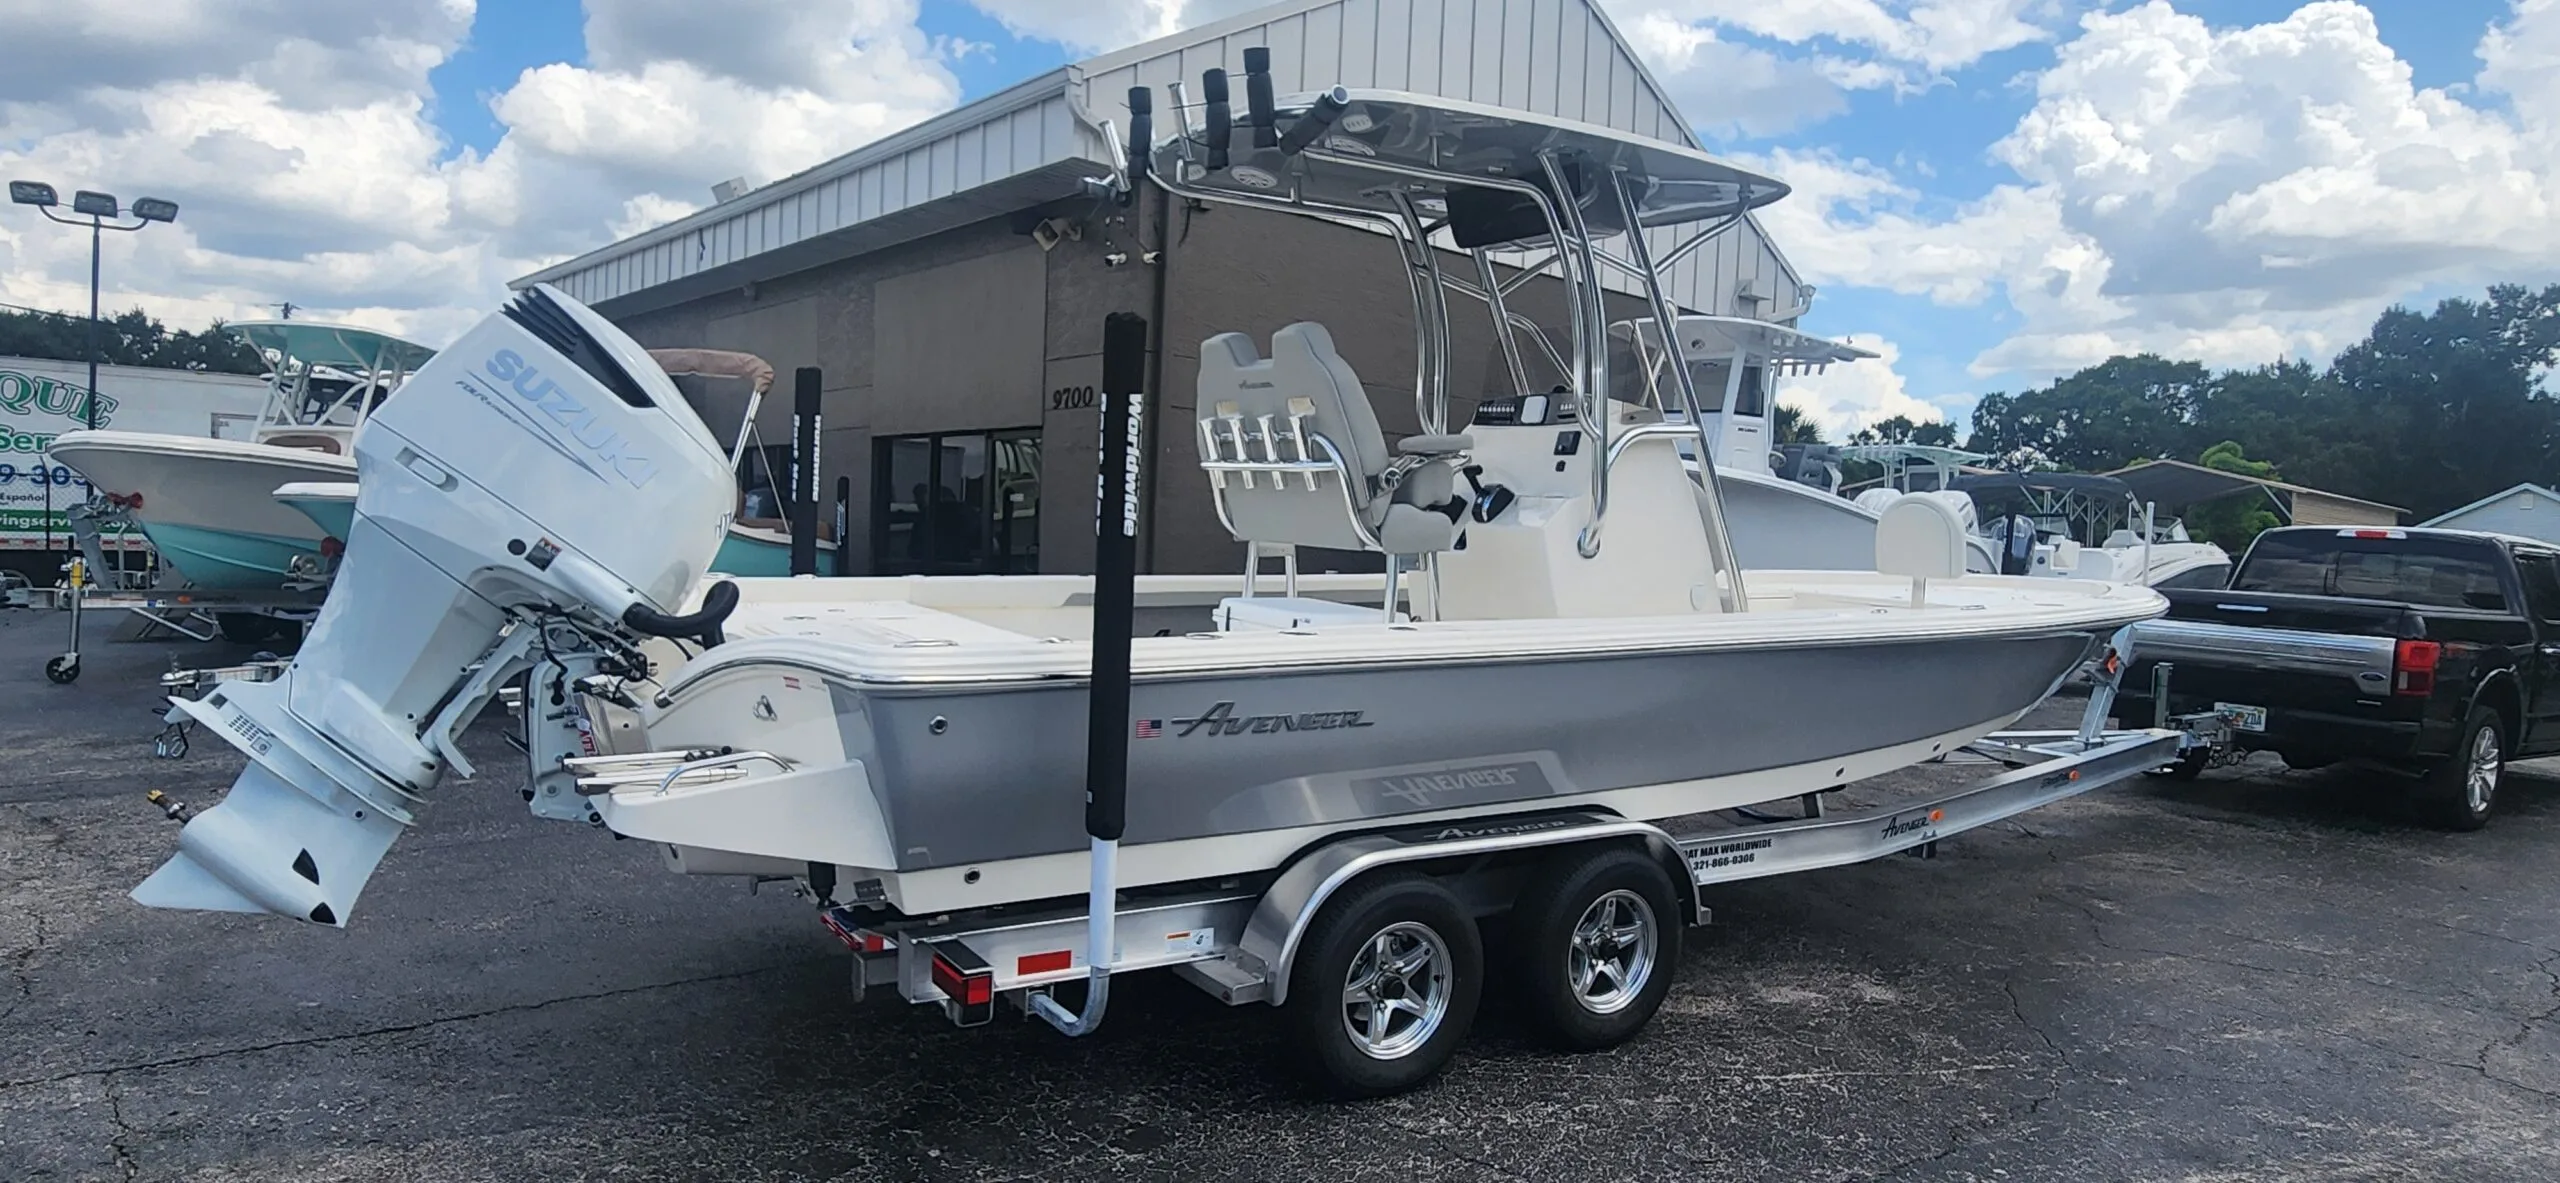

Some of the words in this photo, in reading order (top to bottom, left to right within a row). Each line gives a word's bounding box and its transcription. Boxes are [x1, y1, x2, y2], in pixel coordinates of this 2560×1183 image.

[486, 349, 659, 489] SUZUKI
[1053, 386, 1094, 410] 9700
[1123, 393, 1144, 537] Worldwide
[1700, 846, 1719, 857] MAX
[1720, 839, 1773, 854] WORLDWIDE
